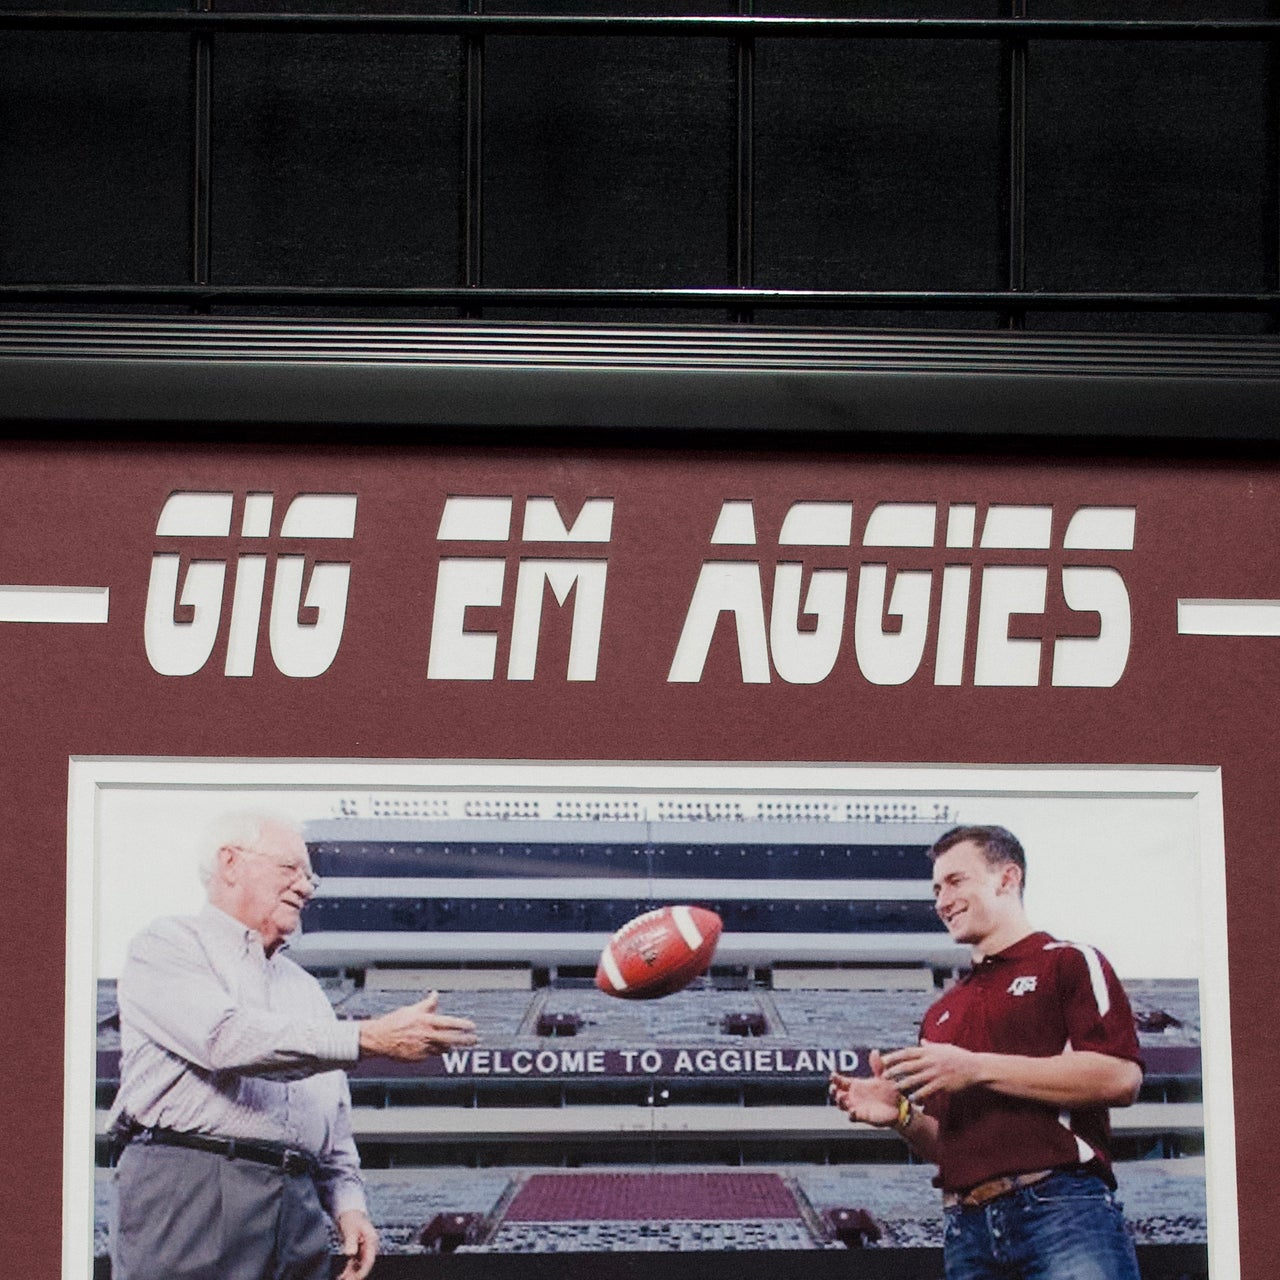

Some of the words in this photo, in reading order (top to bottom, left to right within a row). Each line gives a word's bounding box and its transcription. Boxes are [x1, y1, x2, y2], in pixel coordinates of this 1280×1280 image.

[143, 490, 358, 678] GIG
[427, 494, 615, 682] EM
[666, 499, 1137, 688] AGGIES
[442, 1050, 606, 1074] WELCOME
[620, 1050, 663, 1073] TO
[674, 1049, 860, 1073] AGGIELAND
